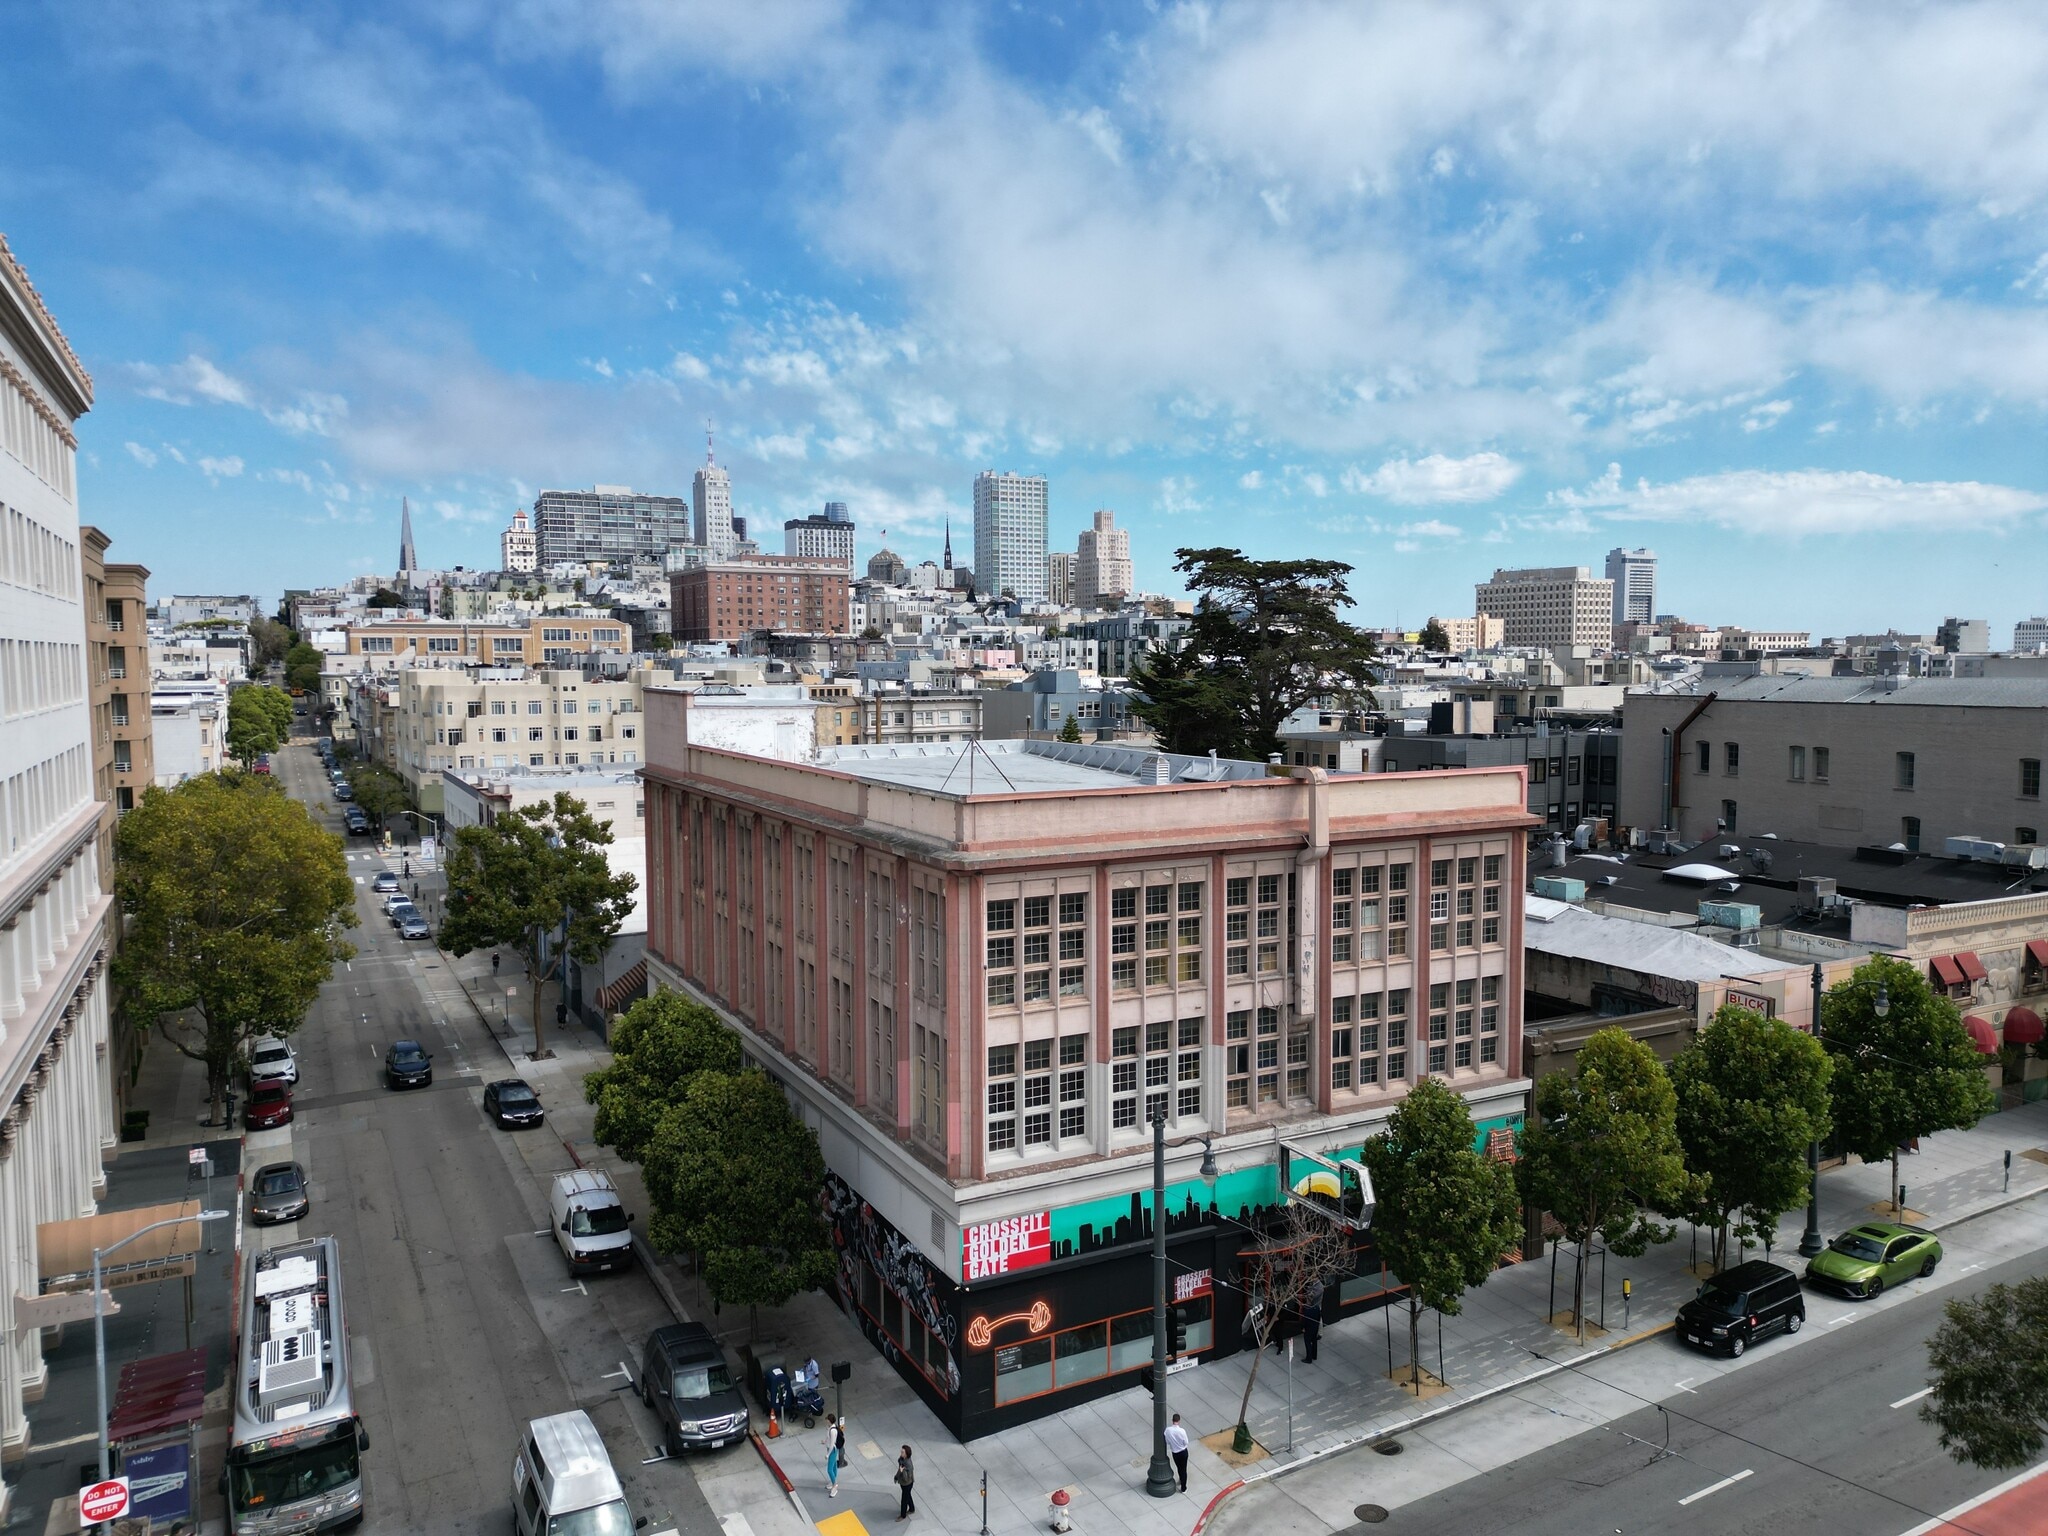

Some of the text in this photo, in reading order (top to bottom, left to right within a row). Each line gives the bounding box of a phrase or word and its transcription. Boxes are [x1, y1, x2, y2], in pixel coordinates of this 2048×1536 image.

[1730, 994, 1764, 1011] BLICK
[969, 1213, 1044, 1243] CROSSFIT
[969, 1233, 1029, 1261] GOLDEN
[969, 1253, 1008, 1279] GATE
[1177, 1269, 1209, 1284] CROSSFIT
[1177, 1278, 1202, 1291] GOLDEN
[1177, 1287, 1193, 1300] GATE
[250, 1441, 265, 1453] 12
[131, 1456, 155, 1466] Ashby
[88, 1485, 121, 1501] DO NOT
[91, 1503, 119, 1516] ENTER
